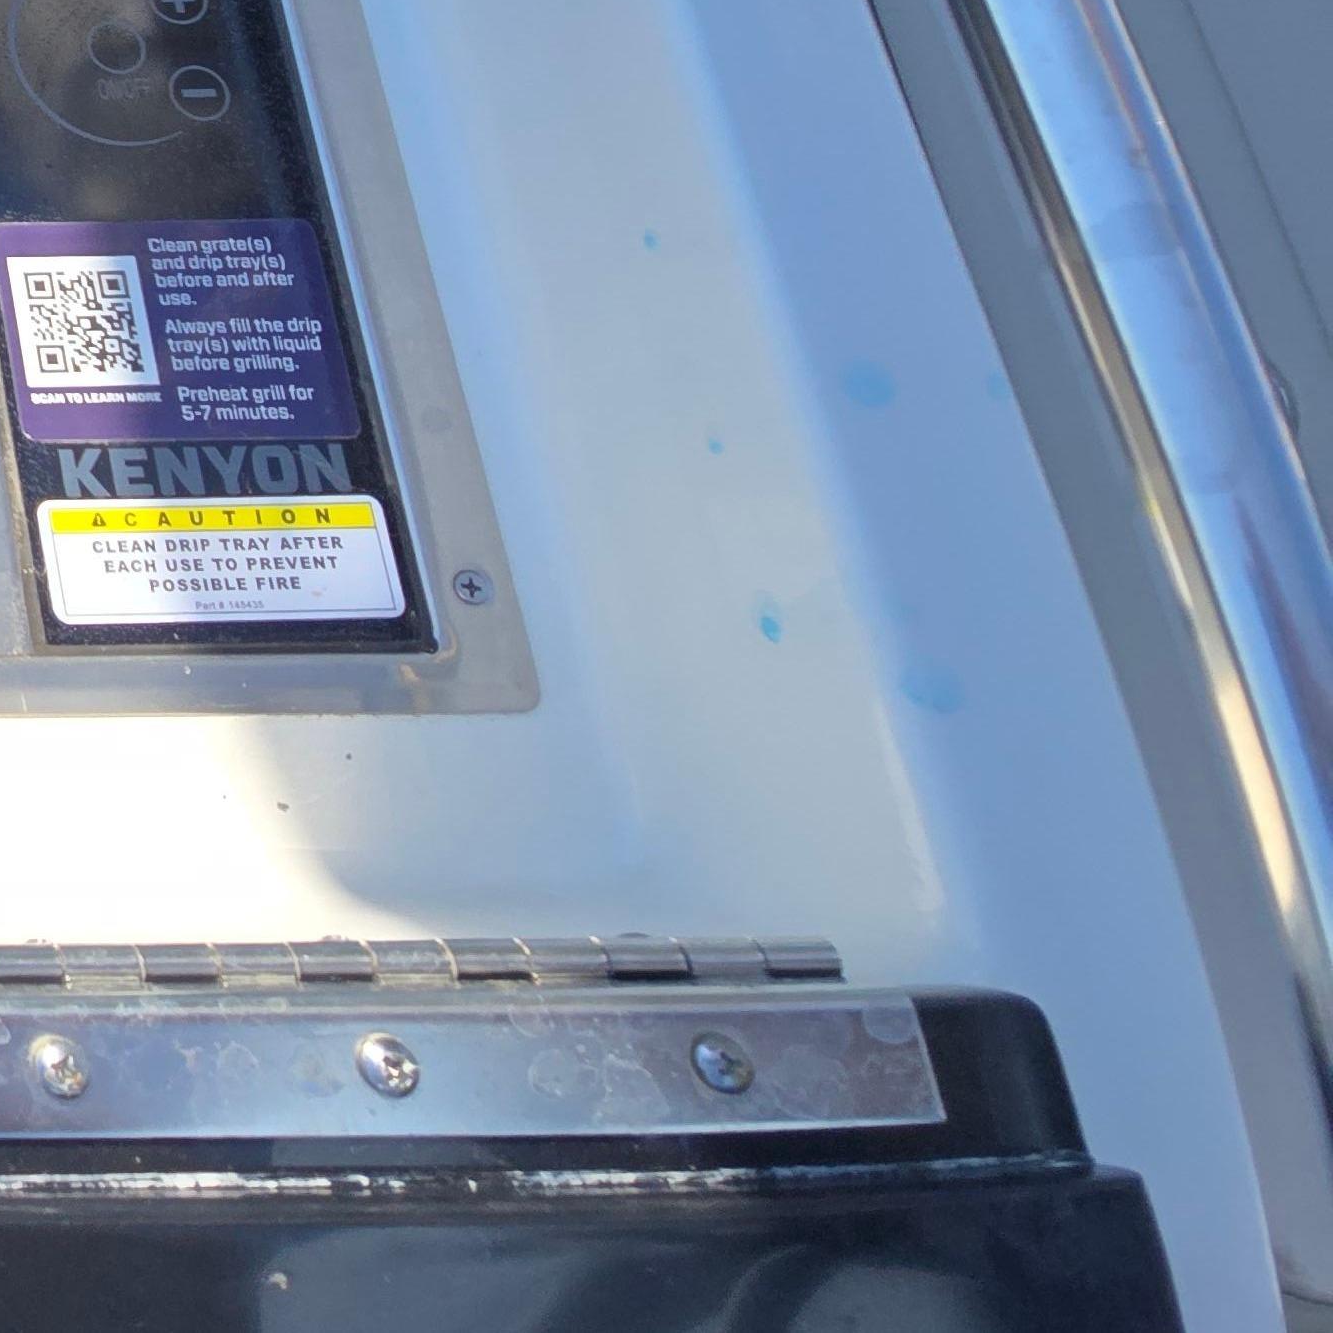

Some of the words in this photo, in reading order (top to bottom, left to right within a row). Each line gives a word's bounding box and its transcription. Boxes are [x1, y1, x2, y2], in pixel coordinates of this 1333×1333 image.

[147, 237, 198, 253] Clean
[200, 236, 272, 254] grate(s)
[151, 255, 186, 271] and
[188, 254, 223, 271] drip
[226, 253, 286, 271] tray(s)
[154, 273, 214, 288] before
[216, 272, 250, 287] and
[252, 272, 295, 287] after
[158, 292, 198, 306] use.
[165, 318, 228, 336] Always
[229, 317, 252, 333] fill
[253, 317, 284, 333] the
[287, 317, 322, 334] drip
[167, 337, 230, 354] tray(s)
[232, 335, 271, 352] with
[273, 335, 322, 353] liquid
[171, 355, 230, 371] before
[233, 354, 300, 373] grilling.
[30, 392, 66, 405] SCAN
[66, 392, 83, 404] TO
[83, 391, 126, 404] LEARN
[125, 391, 163, 403] MORE
[177, 386, 250, 402] Preheat
[252, 384, 286, 404] grill
[288, 384, 315, 401] for
[180, 404, 212, 421] 5-7
[215, 404, 295, 421] minutes.
[58, 443, 354, 498] KENYON
[124, 507, 331, 527] CAUTION
[92, 539, 157, 554] CLEAN
[164, 538, 211, 553] DRIP
[218, 537, 271, 552] TRAY
[279, 536, 344, 551] AFTER
[103, 559, 158, 574] EACH
[165, 558, 205, 573] USE
[211, 557, 238, 572] TO
[245, 556, 338, 571] PREVENT
[149, 577, 249, 593] POSSIBLE
[255, 576, 302, 591] FIRE
[195, 600, 216, 610] Part
